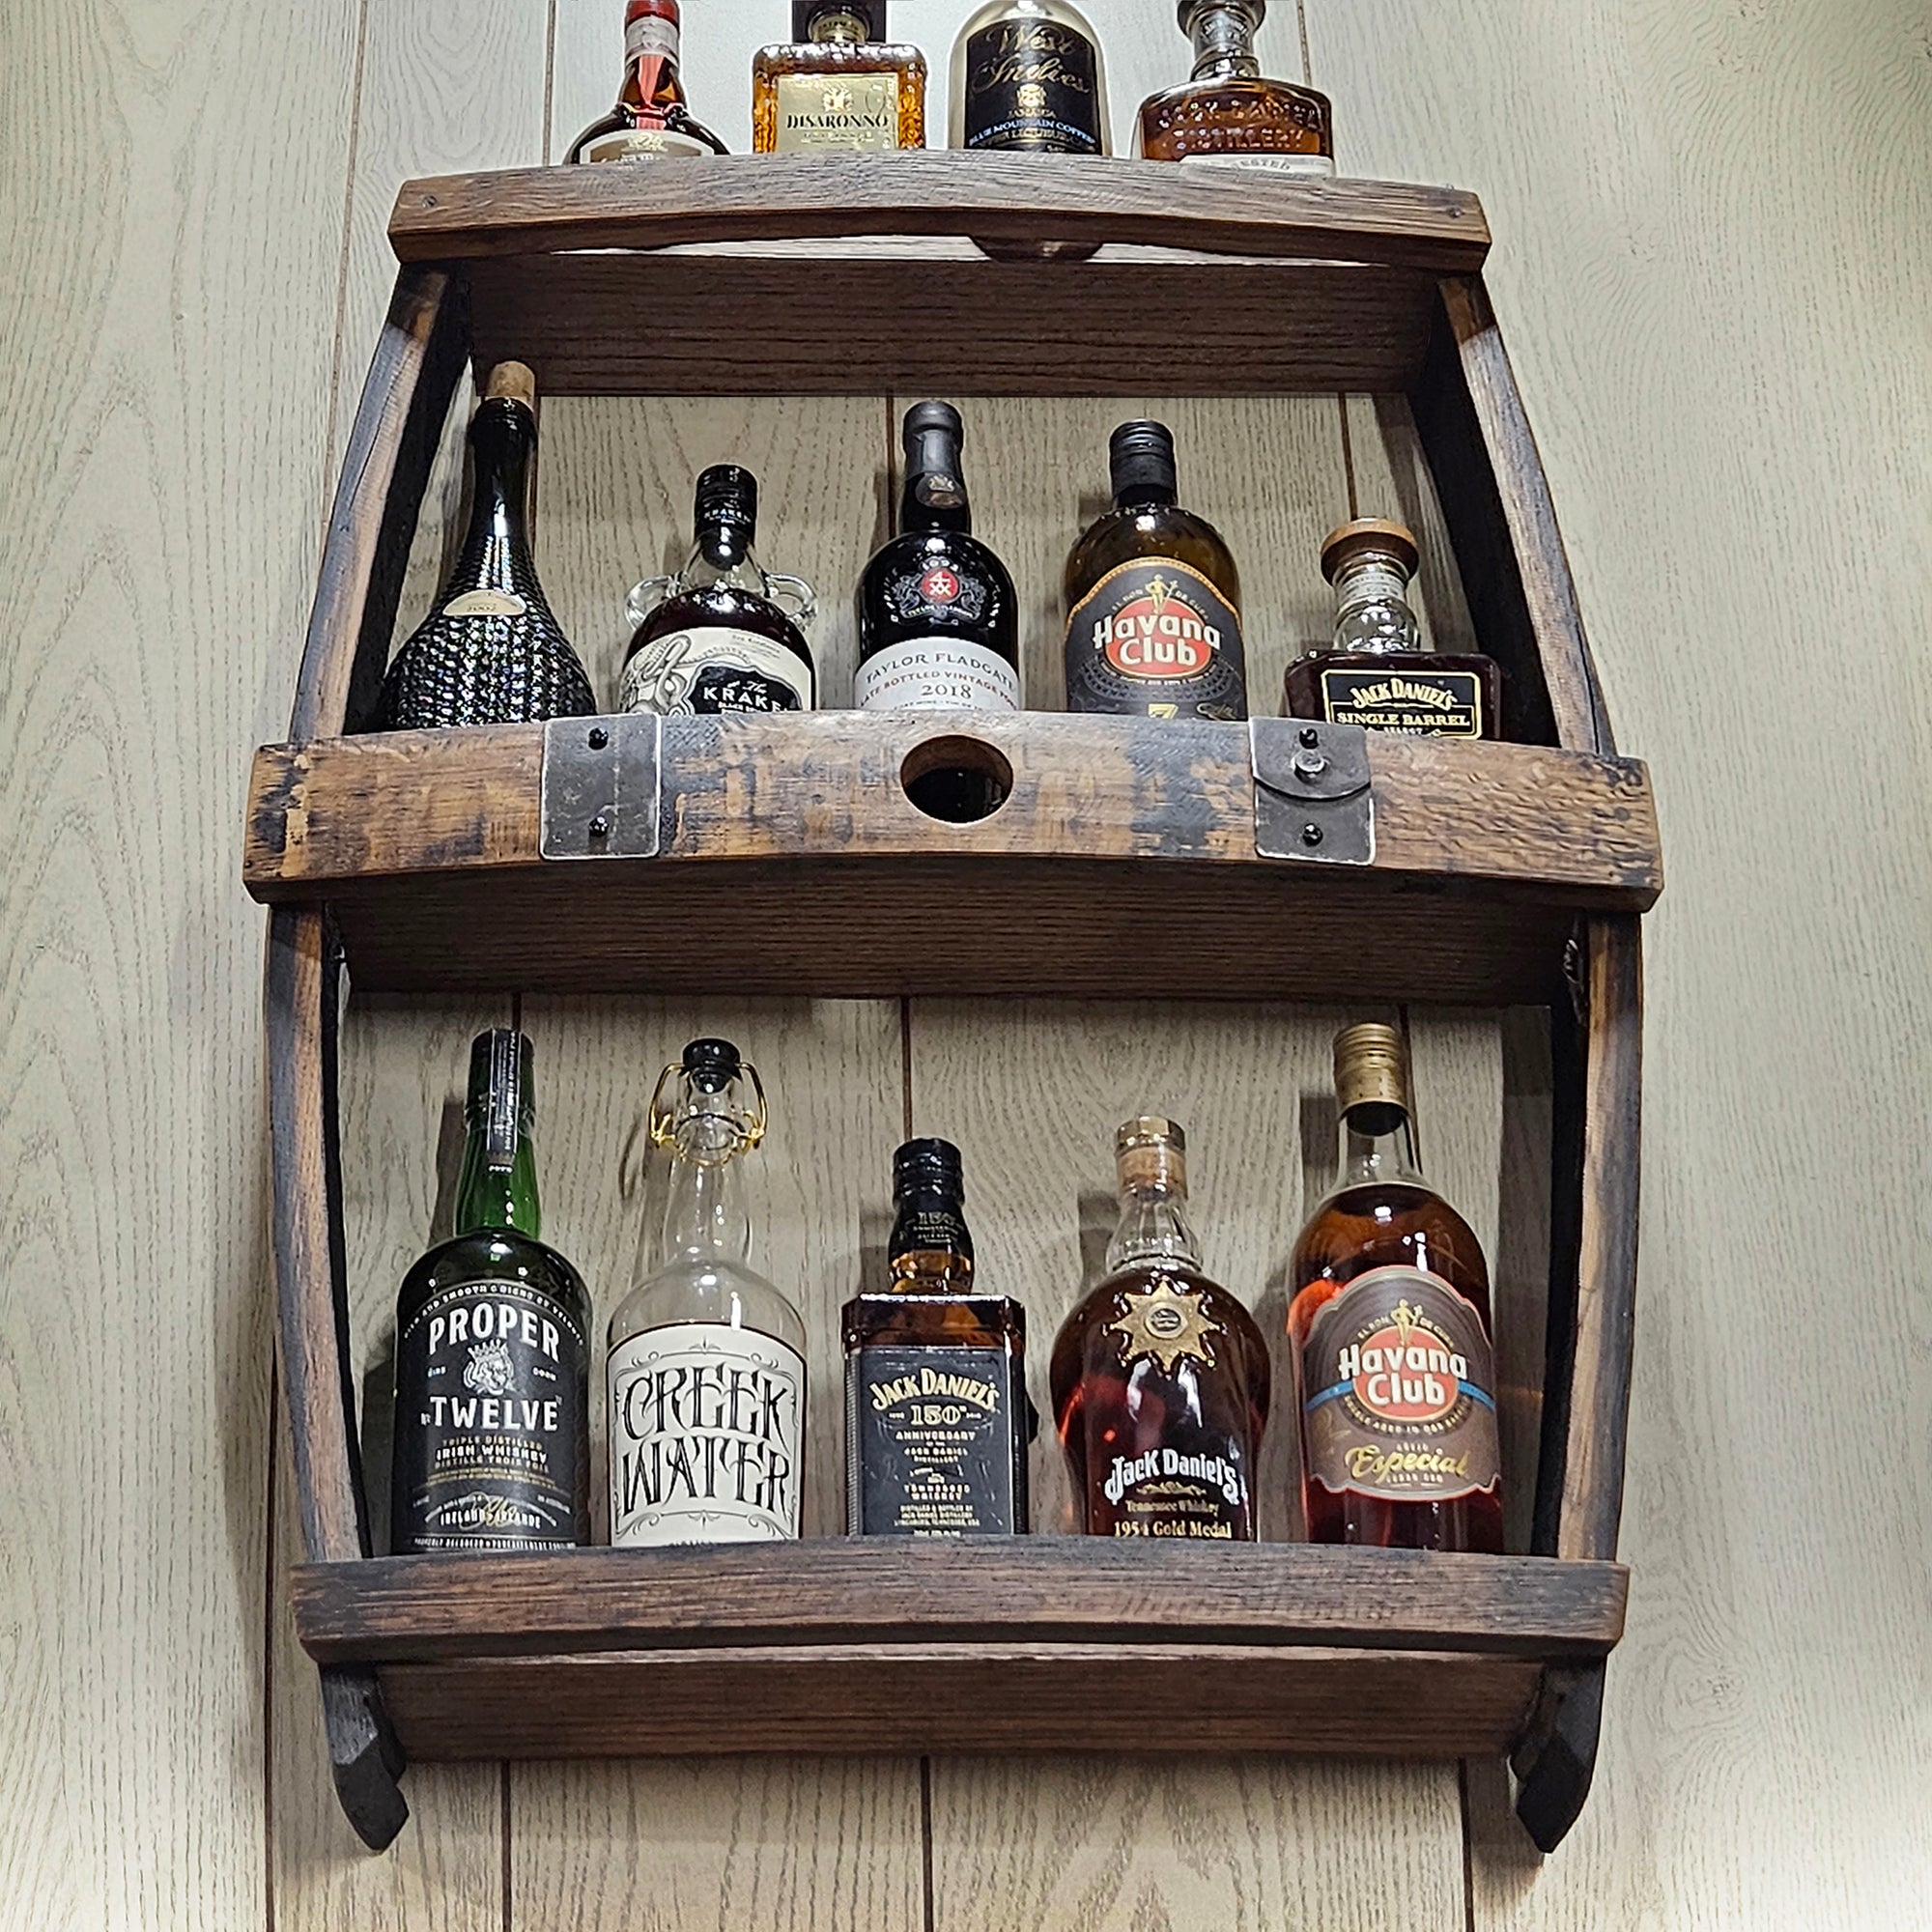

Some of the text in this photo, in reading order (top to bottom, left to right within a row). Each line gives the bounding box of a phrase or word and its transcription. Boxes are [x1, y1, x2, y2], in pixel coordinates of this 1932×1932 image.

[787, 114, 888, 128] DISARONNO
[1093, 614, 1220, 650] Havana
[1120, 637, 1197, 666] Club
[867, 654, 928, 684] TAYLOR
[884, 670, 941, 690] BOTTLED
[945, 670, 997, 694] VINTAGE
[703, 687, 789, 713] KRAKE
[921, 684, 972, 699] 2018
[1350, 677, 1458, 711] JACK DANIEL'S
[1148, 703, 1179, 720] 7
[1337, 712, 1470, 726] SINGLE BARREL
[429, 1302, 559, 1364] PROPER
[1339, 1344, 1467, 1380] Havana
[869, 1368, 1000, 1412] JACK DANIEL'S
[1368, 1372, 1446, 1406] Club
[430, 1397, 557, 1432] TWELVE
[622, 1362, 791, 1456] CREEK
[437, 1445, 547, 1464] IRISH WHISKEY
[1345, 1443, 1471, 1485] Especial
[622, 1435, 790, 1524] WATER
[1104, 1448, 1239, 1505] Jack Daniel's
[1114, 1520, 1232, 1539] 1954 Gold Medal
